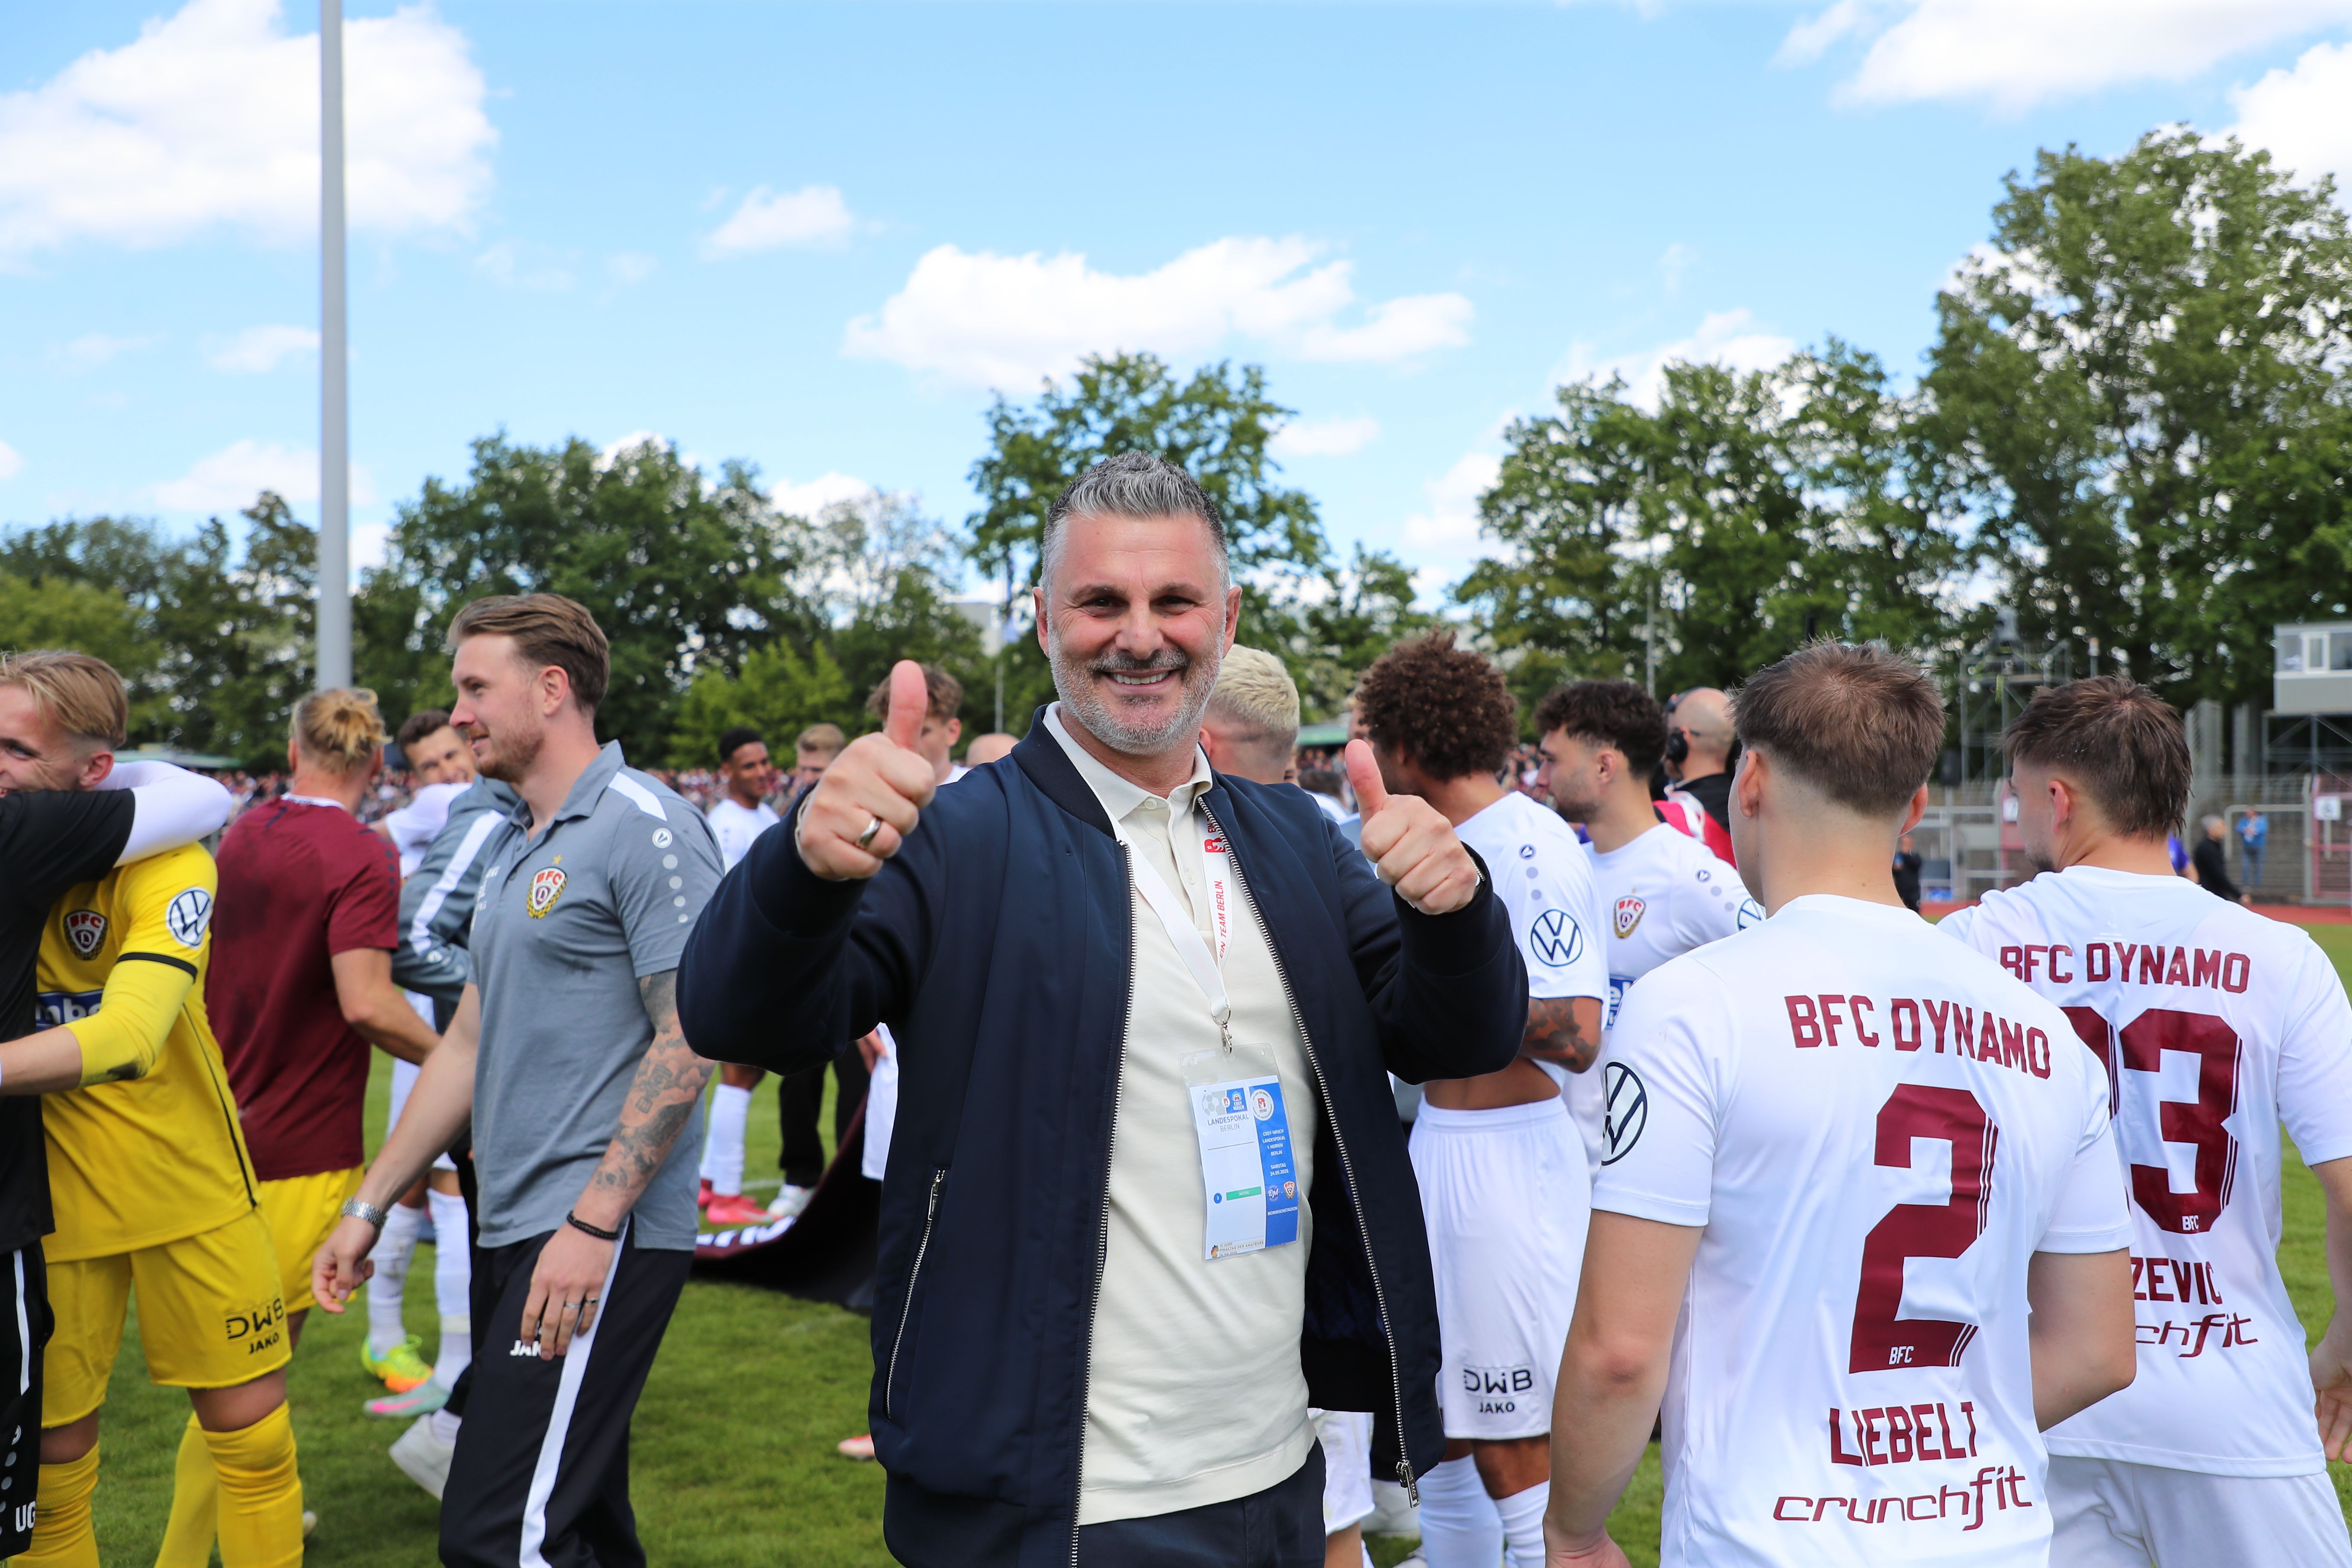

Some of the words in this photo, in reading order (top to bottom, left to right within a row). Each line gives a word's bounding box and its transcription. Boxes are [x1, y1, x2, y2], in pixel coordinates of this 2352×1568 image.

[1214, 879, 1225, 911] BERLIN.
[69, 913, 103, 929] BFC
[1218, 913, 1227, 938] TEAM
[2000, 945, 2073, 983] BFC
[2086, 942, 2250, 993] DYNAMO
[1784, 995, 1879, 1048] BFC
[1890, 998, 2051, 1079] DYNAMO
[1207, 1114, 1249, 1126] LANDESPOKAL
[1220, 1123, 1240, 1132] BERLIN
[1270, 1168, 1289, 1176] 24.05.2025
[1267, 1206, 1298, 1216] MOMMSENSTADION
[2181, 1215, 2199, 1231] BFC
[1849, 1083, 1999, 1374] 2
[226, 1298, 284, 1339] DWB
[249, 1332, 279, 1354] JAKO
[1888, 1345, 1914, 1365] BFC
[1464, 1369, 1532, 1393] DWB
[1479, 1402, 1515, 1413] JAKO
[1829, 1402, 1977, 1467] LIEBELT
[1773, 1466, 2033, 1531] crunchfit
[15, 1500, 36, 1533] UG
